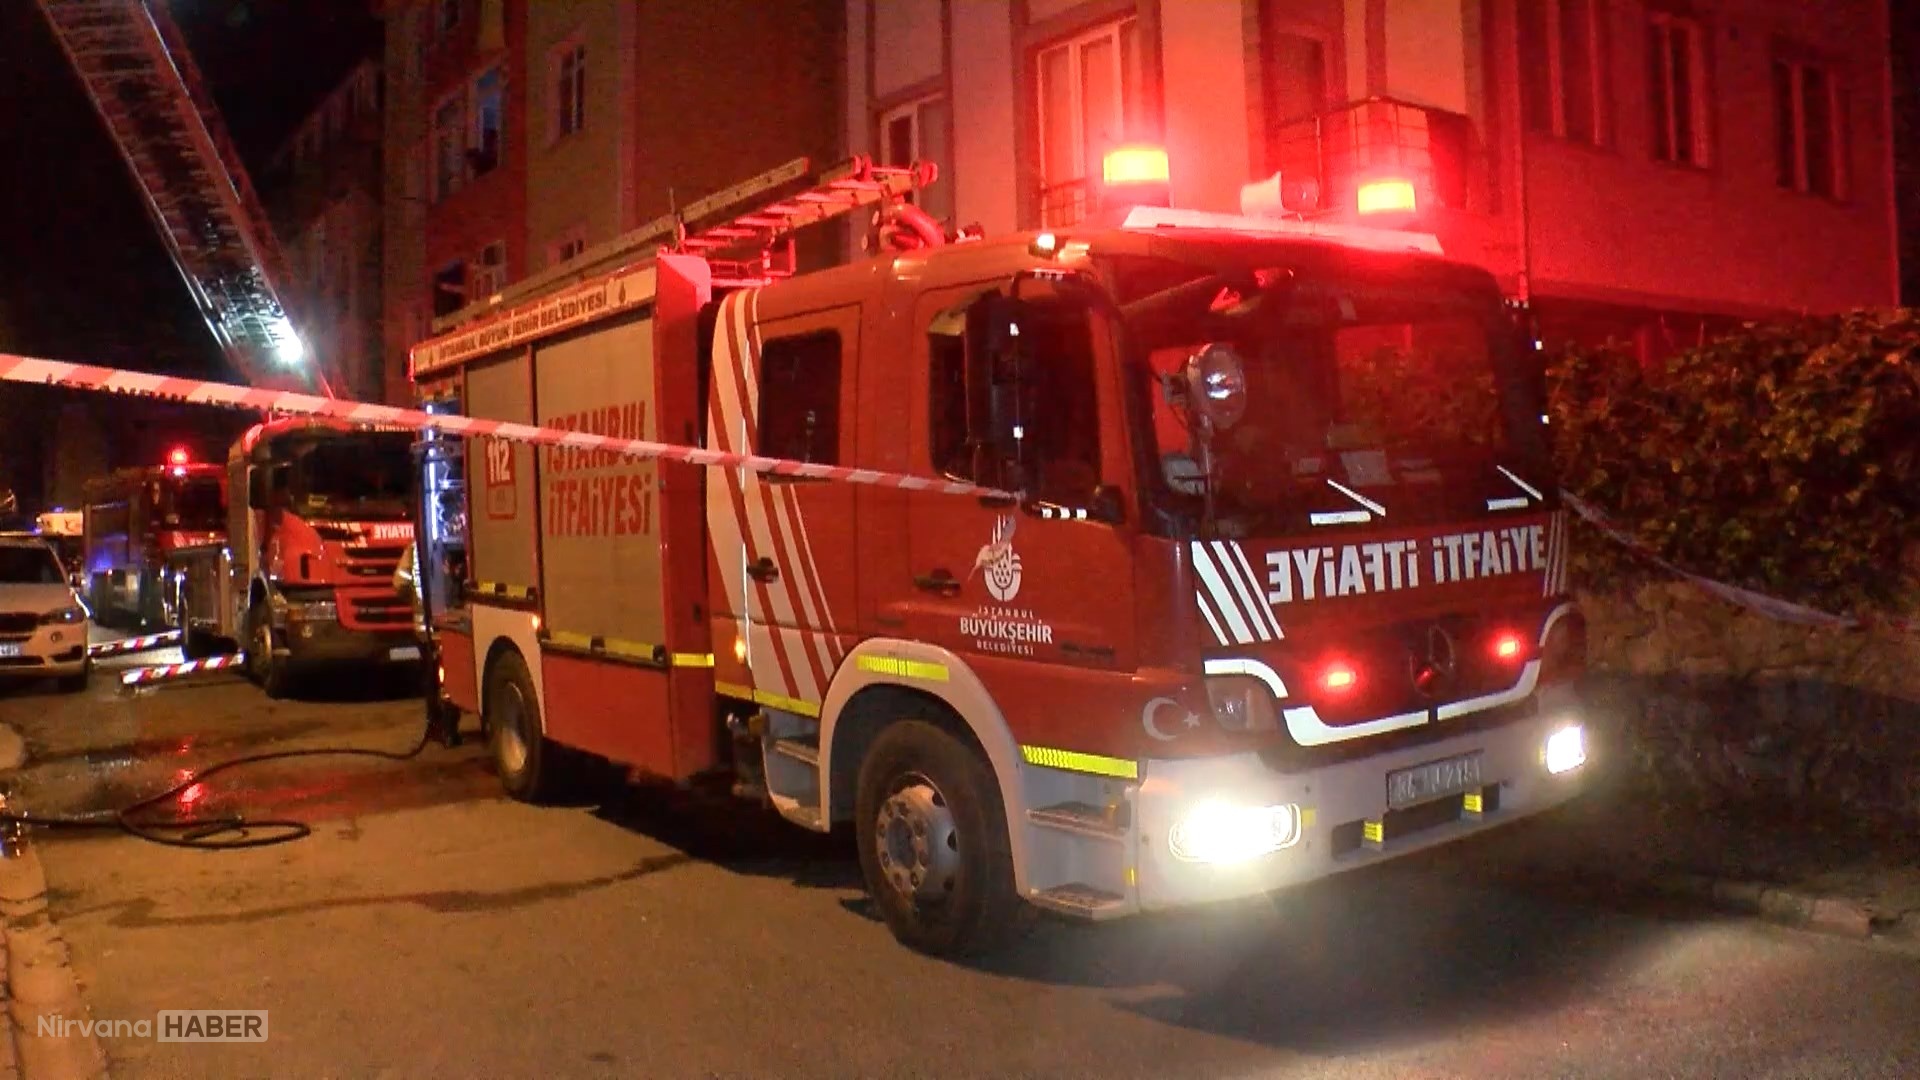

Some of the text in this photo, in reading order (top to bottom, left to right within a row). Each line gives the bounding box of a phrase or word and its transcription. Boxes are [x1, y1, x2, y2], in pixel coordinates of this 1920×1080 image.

[487, 439, 511, 484] 112
[978, 605, 1034, 620] İSTANBUL
[960, 613, 1053, 644] BÜYÜKŞEHİR
[976, 640, 1034, 656] BELEDİYESİ
